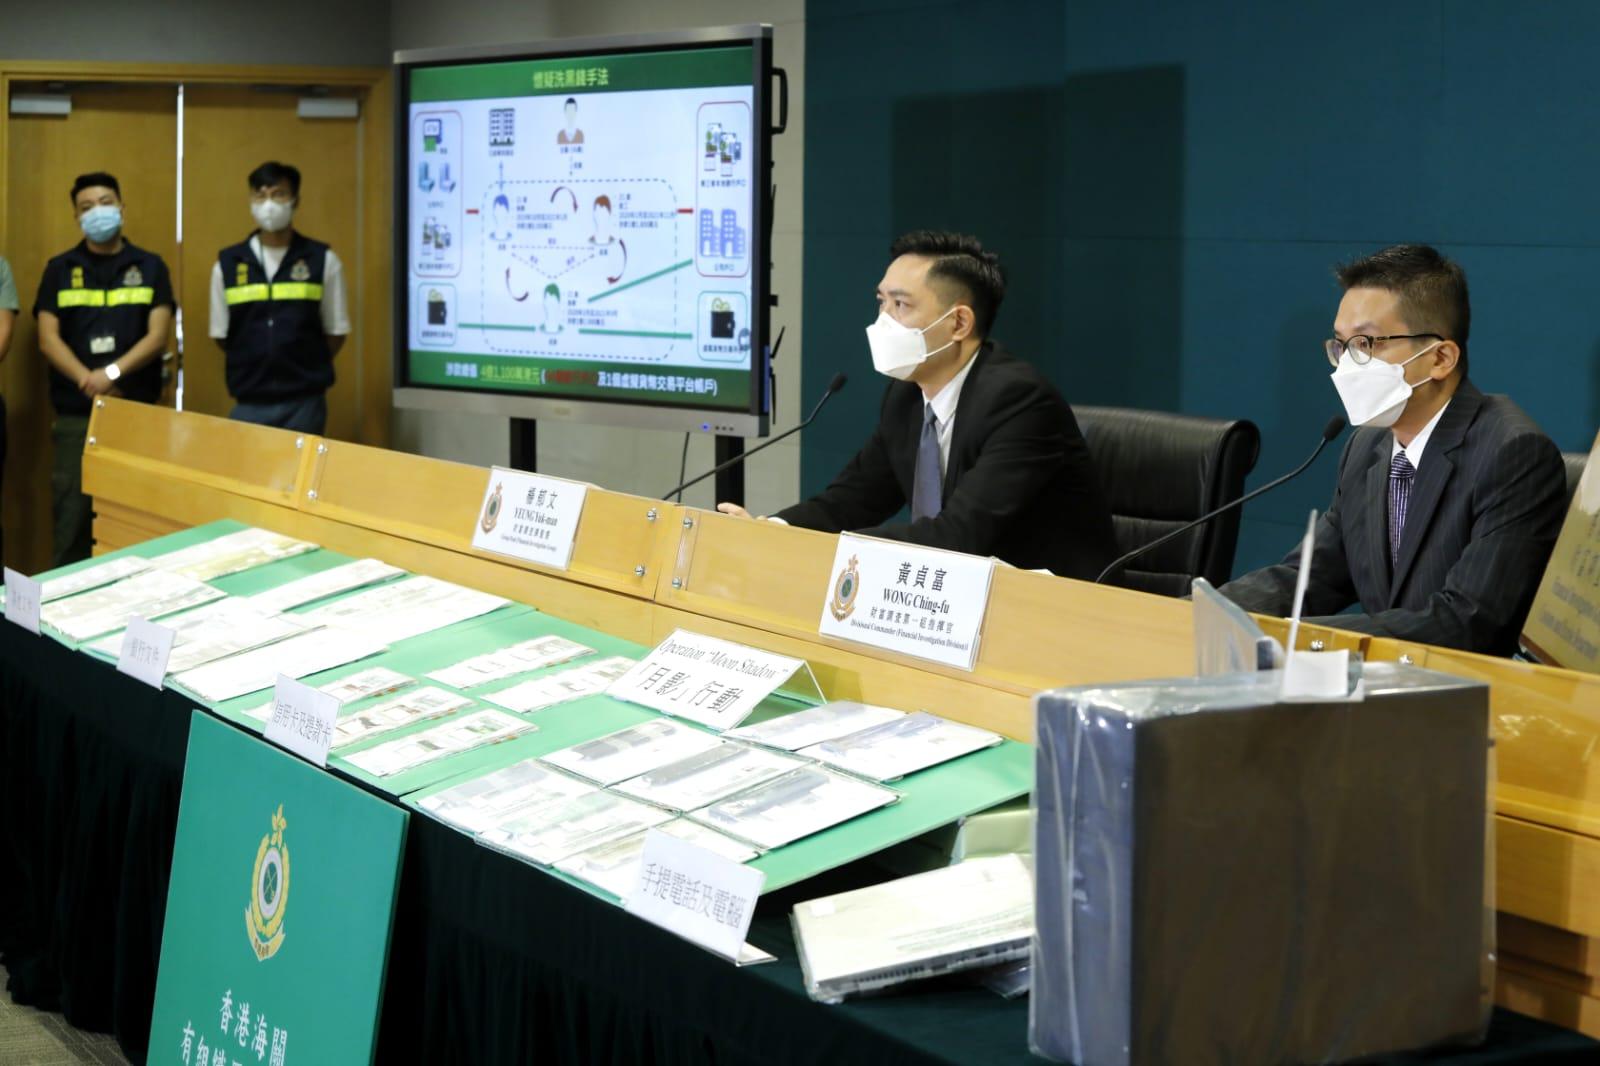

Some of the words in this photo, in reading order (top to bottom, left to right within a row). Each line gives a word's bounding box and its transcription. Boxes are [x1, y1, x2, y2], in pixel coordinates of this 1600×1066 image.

[896, 561, 948, 592] 黃貞富
[883, 587, 912, 608] WONG
[913, 594, 950, 615] Ching-fu
[659, 638, 705, 661] Operation
[642, 863, 747, 929] 手提電話及電腦
[219, 988, 288, 1066] 香港海關
